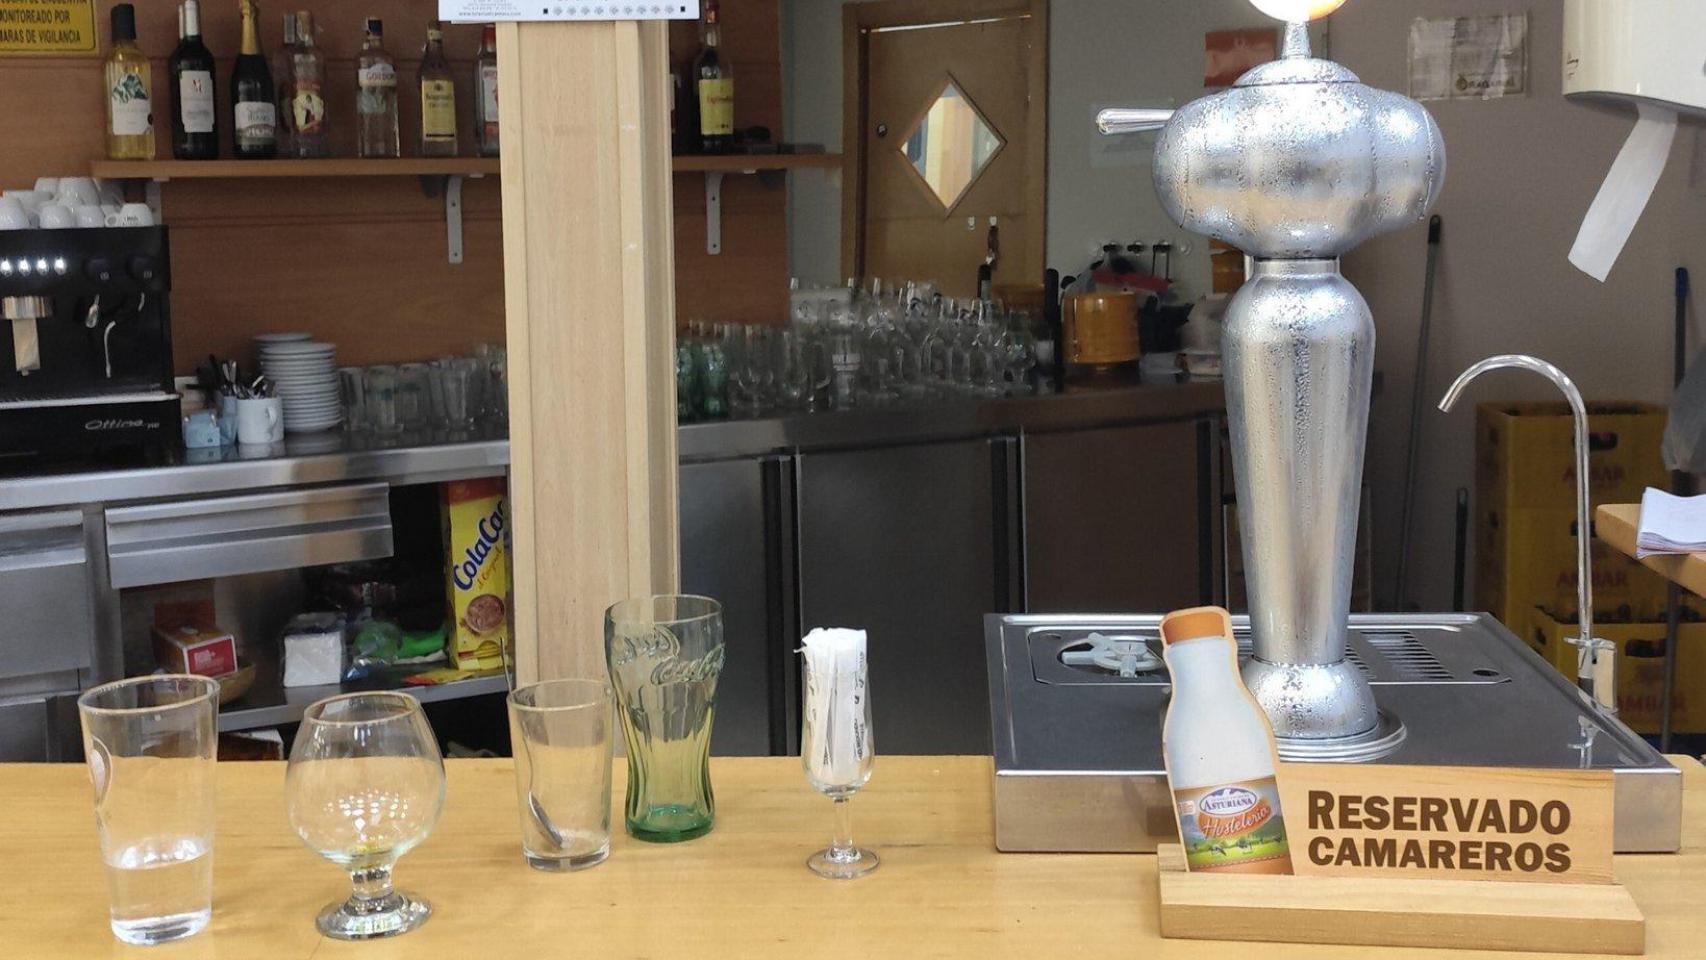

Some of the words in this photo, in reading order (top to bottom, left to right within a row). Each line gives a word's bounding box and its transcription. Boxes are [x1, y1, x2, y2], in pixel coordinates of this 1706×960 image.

[54, 9, 71, 24] POR
[26, 29, 36, 43] DE
[38, 29, 81, 43] VIGILANCIA
[1203, 796, 1253, 811] ASTURIANA
[1308, 790, 1571, 834] RESERVADO
[1308, 837, 1571, 873] CAMAREROS
